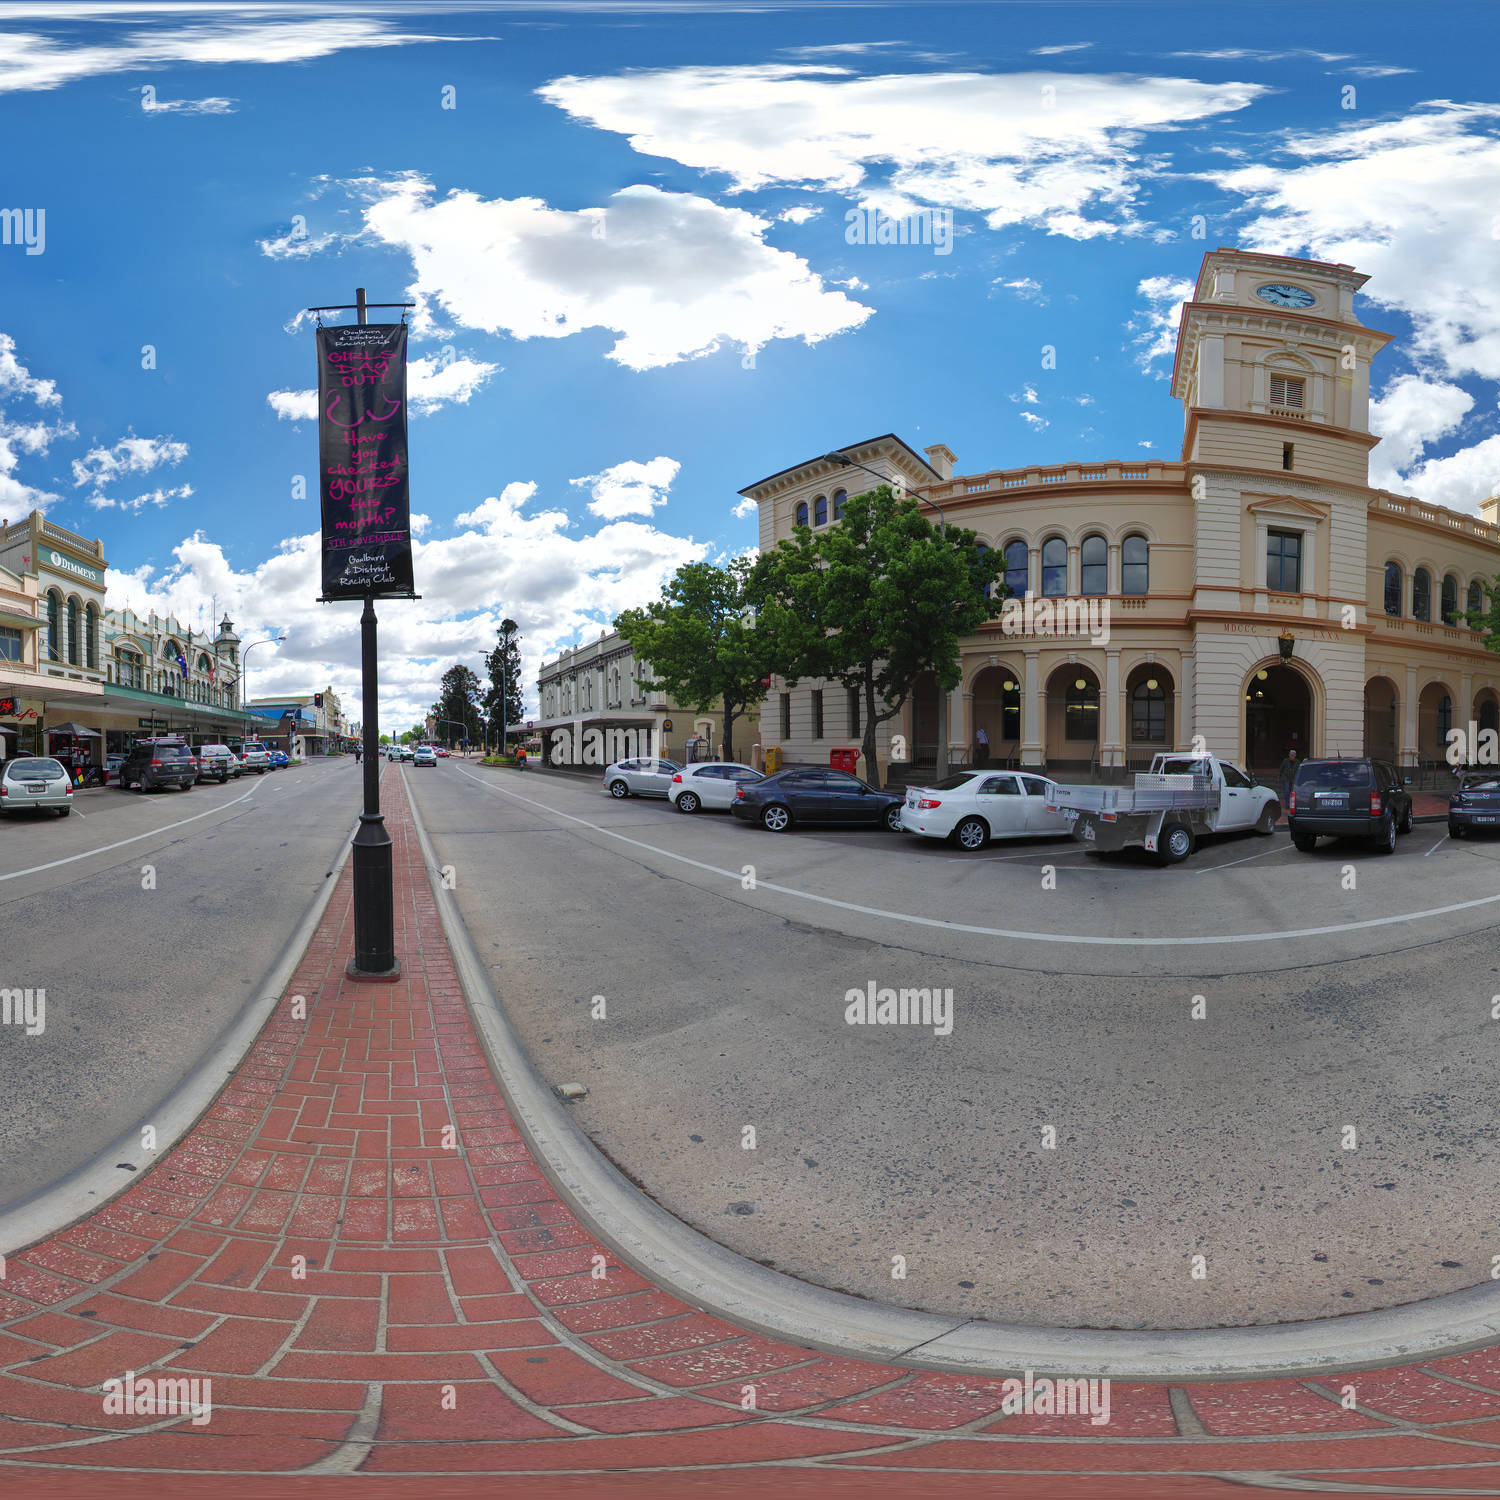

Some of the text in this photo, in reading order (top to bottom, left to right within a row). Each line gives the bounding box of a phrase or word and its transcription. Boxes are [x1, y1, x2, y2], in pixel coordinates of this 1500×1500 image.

[328, 350, 396, 362] GIRLS
[335, 360, 389, 375] DAY
[344, 430, 388, 446] Have
[352, 448, 378, 466] you
[327, 454, 401, 476] checked
[348, 496, 381, 511] this
[335, 506, 396, 530] month?
[349, 532, 405, 546] NOVEMBER
[348, 553, 385, 564] Goulburn
[60, 558, 96, 581] DIMMEYS
[353, 562, 390, 574] District
[340, 572, 396, 588] Racing Club
